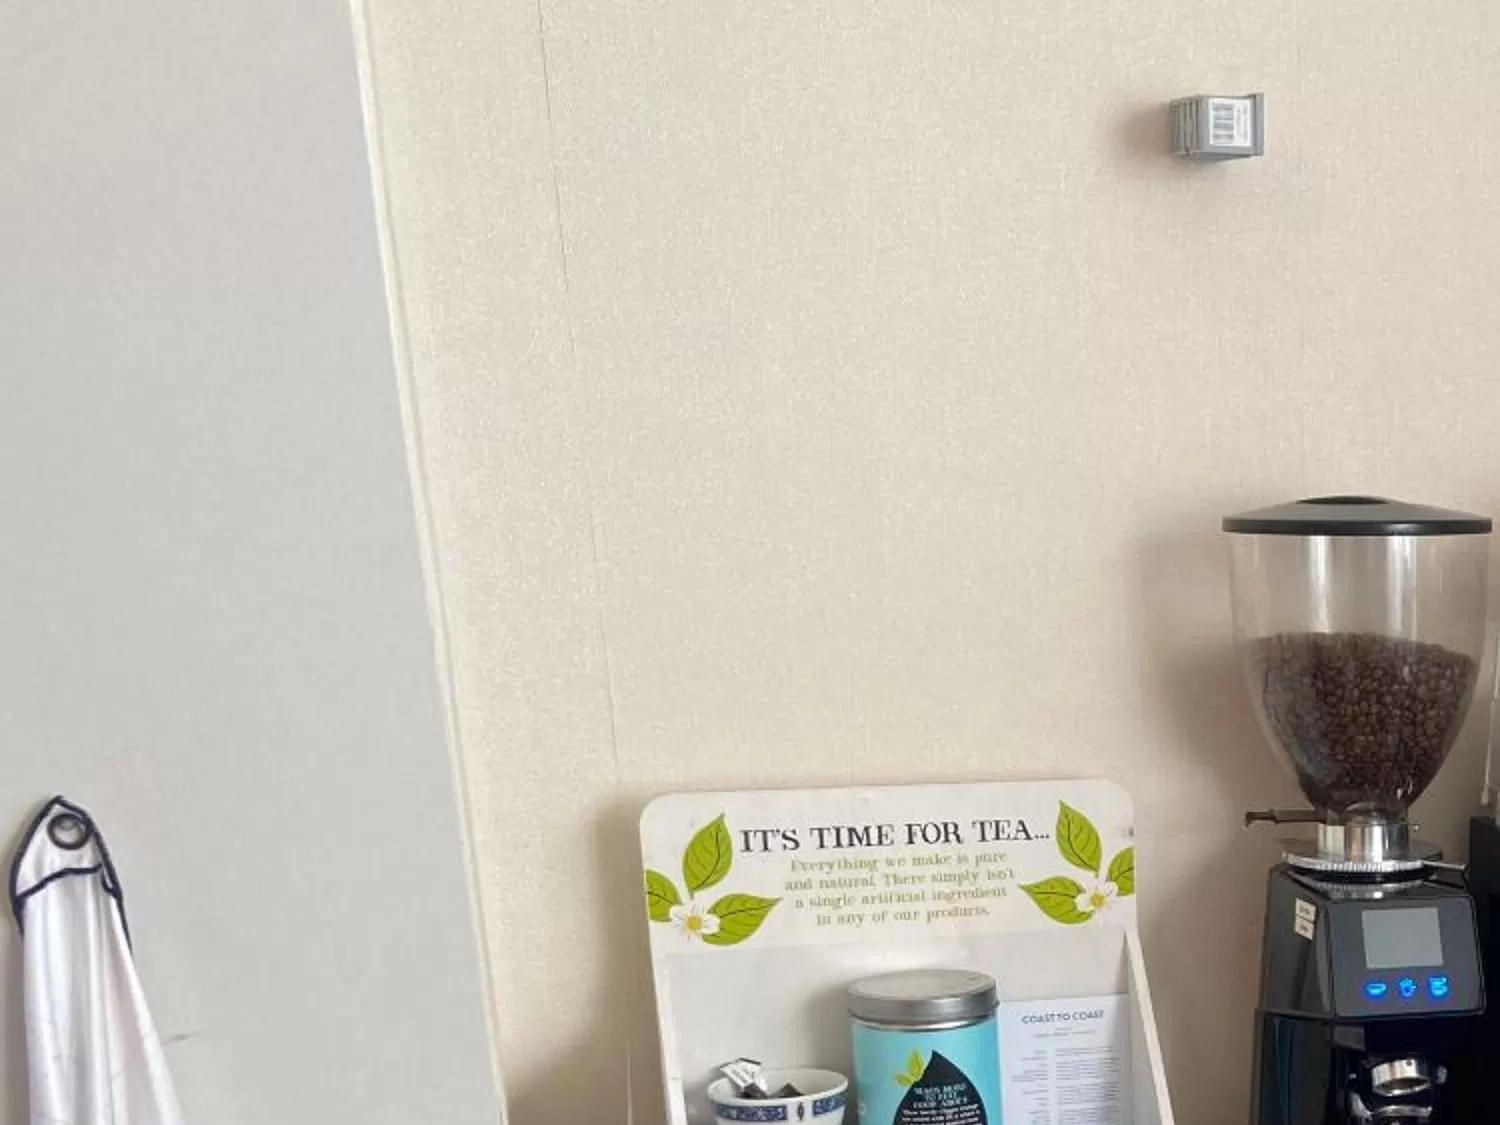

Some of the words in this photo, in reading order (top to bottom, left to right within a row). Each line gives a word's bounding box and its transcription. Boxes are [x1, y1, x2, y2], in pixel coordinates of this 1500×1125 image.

[740, 828, 801, 853] IT'S
[810, 822, 895, 850] TIME
[905, 821, 965, 845] FOR
[972, 819, 1051, 843] TEA...
[790, 856, 879, 875] Everything
[886, 857, 907, 868] we
[912, 853, 953, 867] make
[957, 852, 969, 865] is
[974, 851, 1008, 867] pure
[785, 877, 813, 891] and
[882, 872, 926, 888] There
[931, 870, 979, 886] simply
[987, 867, 1015, 881] isn't
[795, 898, 805, 909] a
[809, 894, 855, 911] single
[861, 890, 926, 905] artificial
[931, 886, 1008, 904] ingredient
[816, 912, 831, 926] in
[837, 911, 865, 927] any
[872, 907, 889, 922] of
[894, 909, 921, 921] our
[1021, 1013, 1056, 1025] COAST
[1057, 1012, 1071, 1022] TO
[1072, 1009, 1105, 1022] COAST
